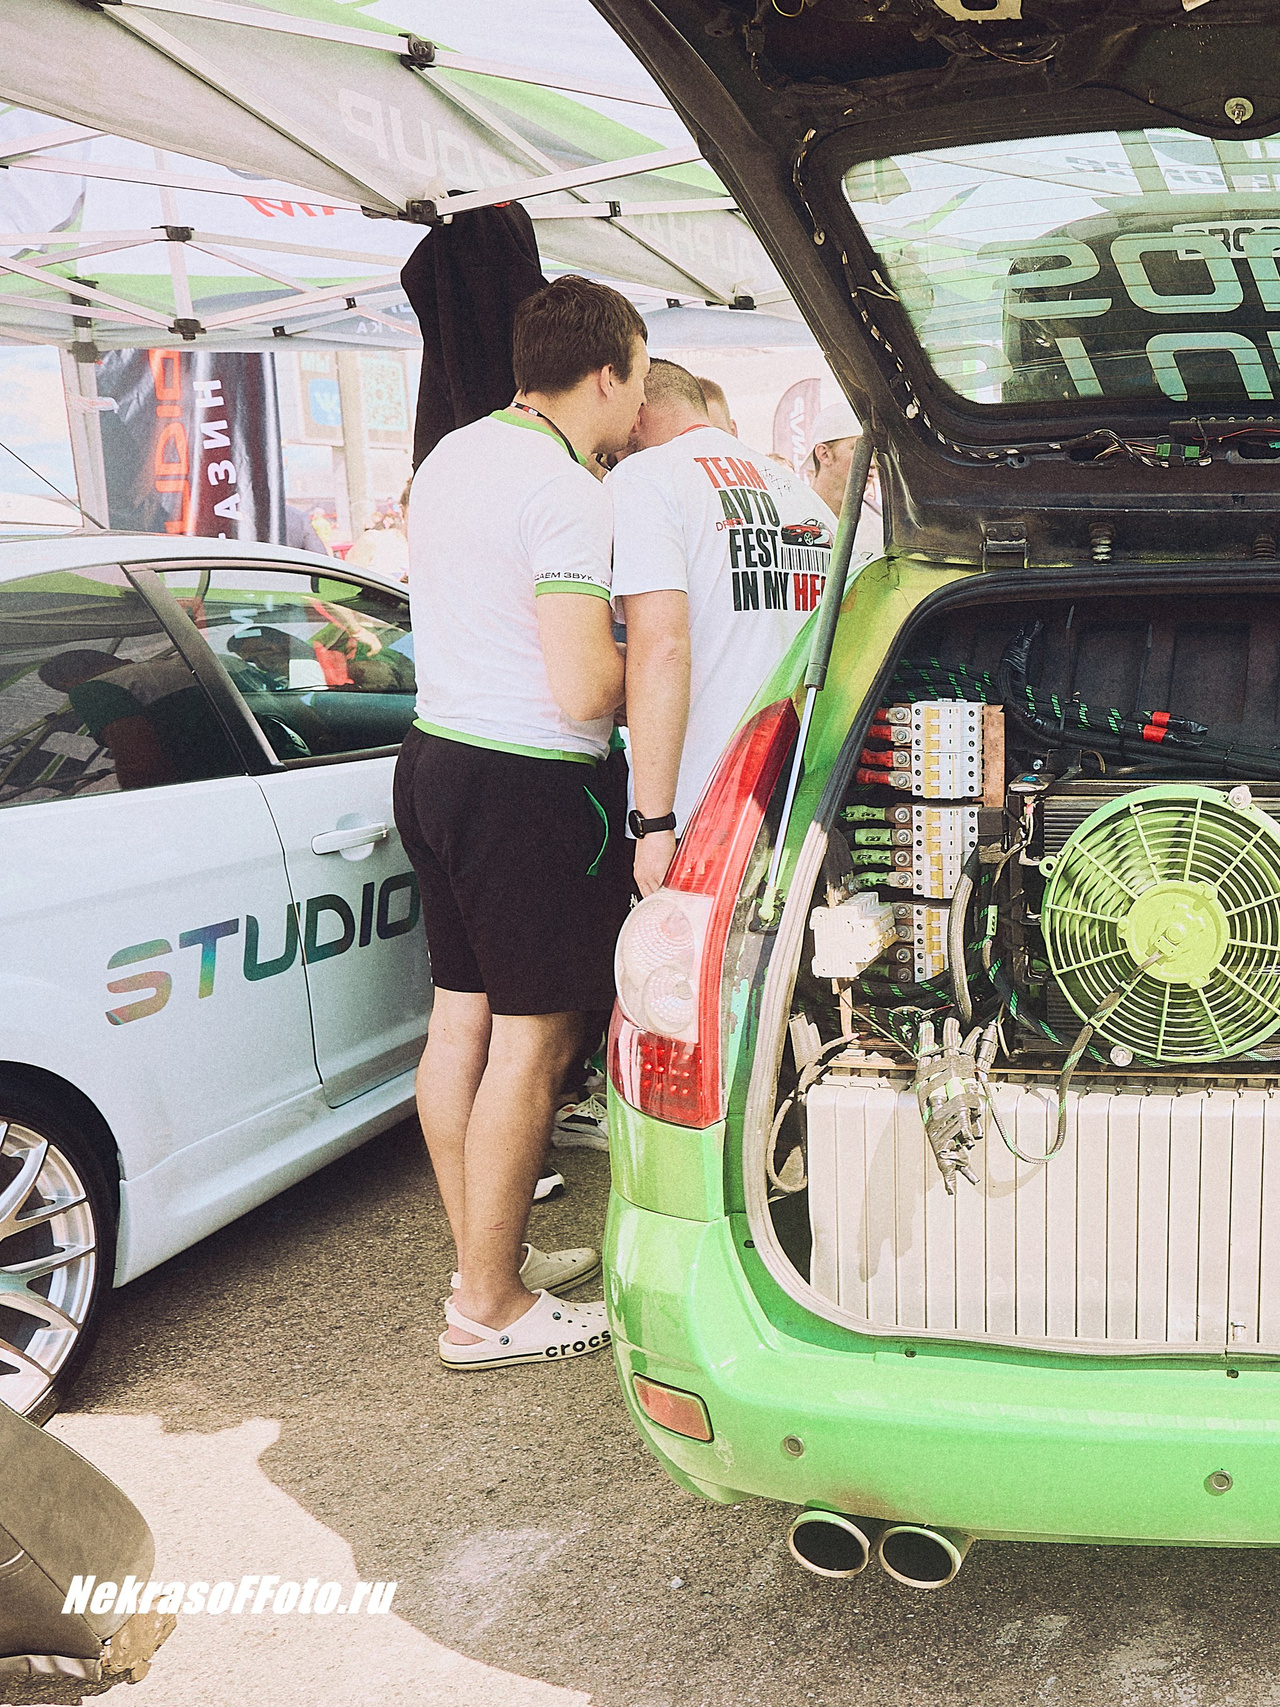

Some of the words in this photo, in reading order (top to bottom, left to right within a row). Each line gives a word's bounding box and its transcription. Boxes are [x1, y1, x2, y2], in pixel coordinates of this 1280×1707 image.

[193, 379, 243, 539] АЗИН
[693, 456, 768, 491] TEAM
[718, 488, 781, 528] AVTO
[728, 528, 779, 569] FEST
[731, 571, 760, 612] IN
[763, 570, 790, 611] MY
[793, 573, 827, 612] HE
[105, 870, 422, 1026] STUDIO
[544, 1326, 612, 1359] crocs
